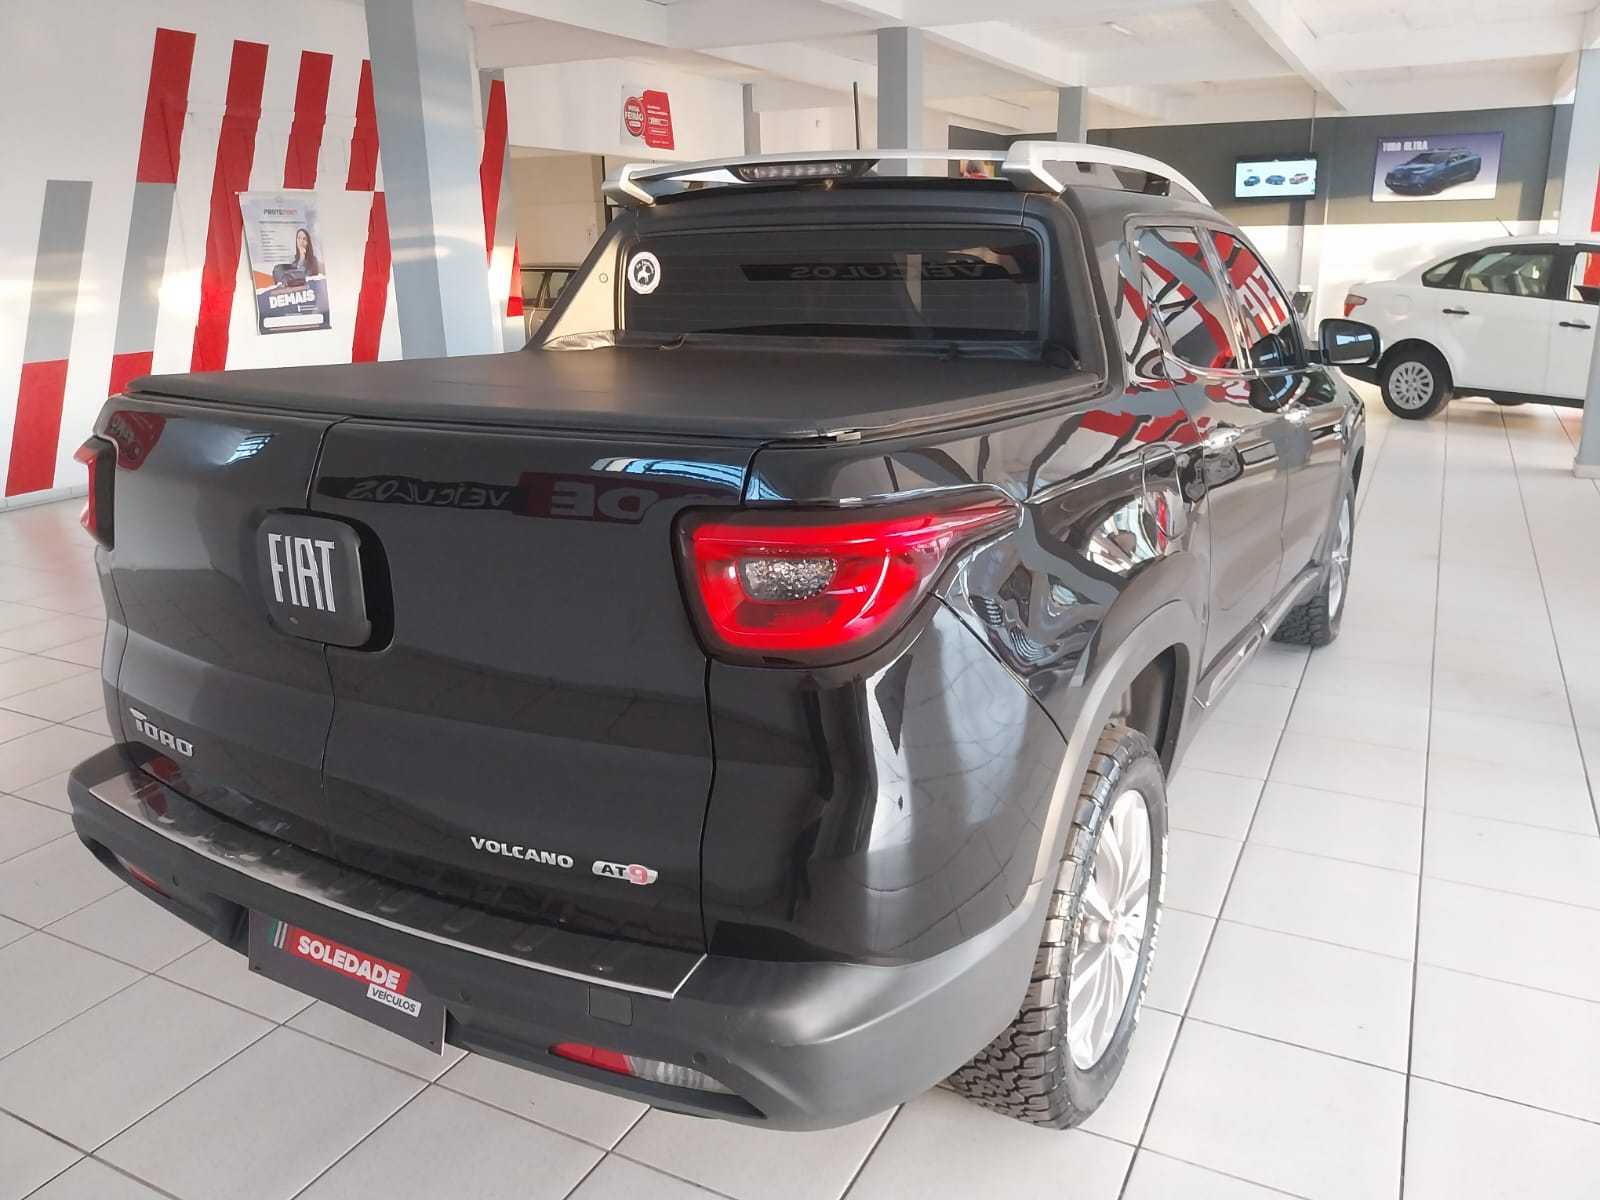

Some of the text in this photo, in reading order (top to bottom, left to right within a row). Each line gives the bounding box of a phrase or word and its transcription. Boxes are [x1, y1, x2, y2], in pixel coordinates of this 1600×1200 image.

[268, 289, 316, 308] DEMAIS
[268, 533, 336, 612] FIAT
[129, 707, 193, 757] TORO
[470, 836, 648, 885] VOLCANO AT9
[297, 935, 401, 990] SOLEDADE
[371, 987, 416, 1013] VEÍCULOS
